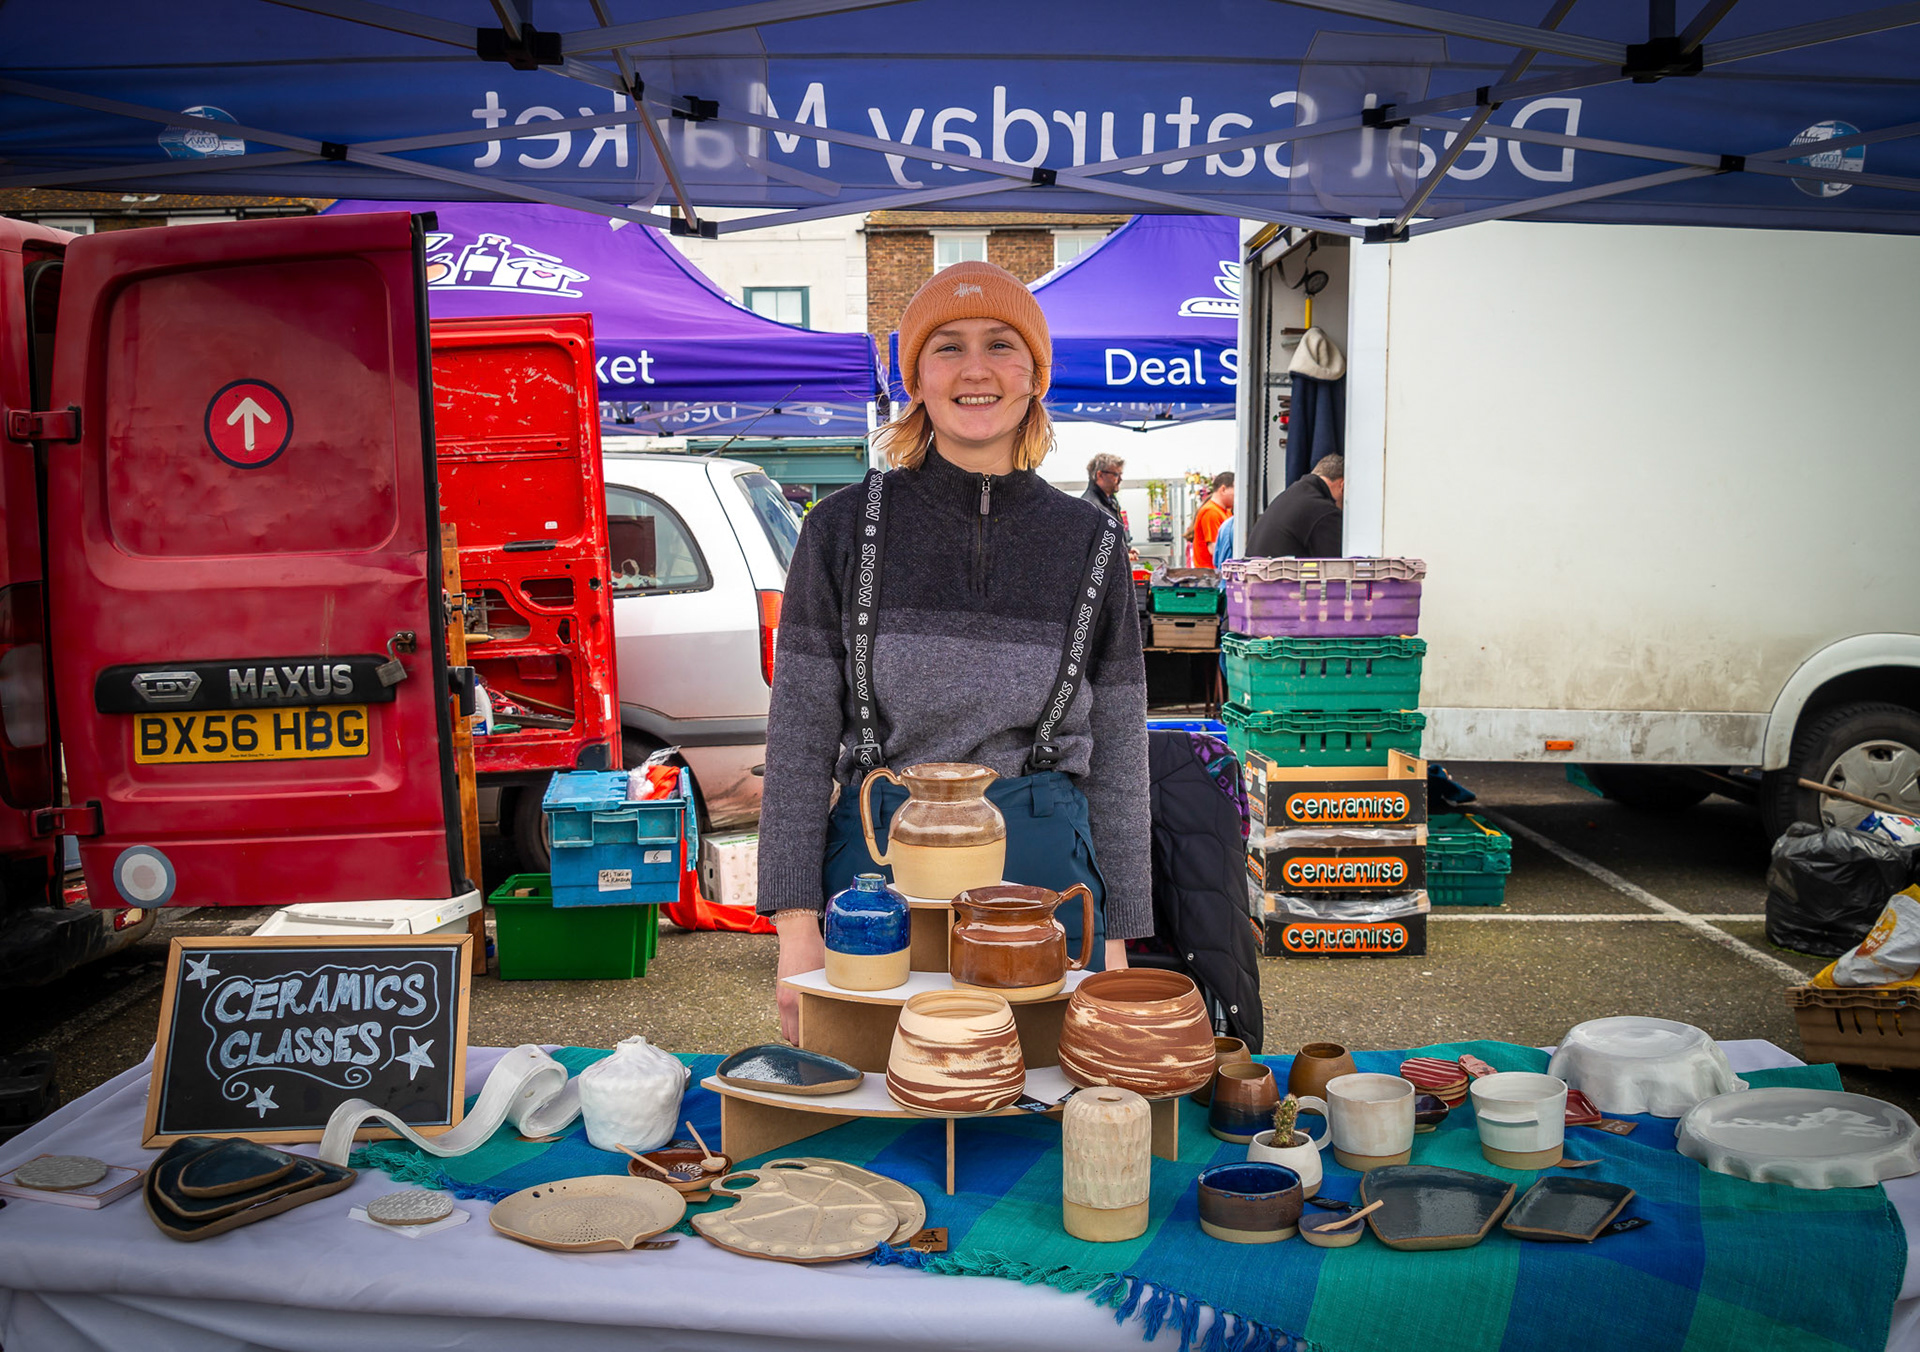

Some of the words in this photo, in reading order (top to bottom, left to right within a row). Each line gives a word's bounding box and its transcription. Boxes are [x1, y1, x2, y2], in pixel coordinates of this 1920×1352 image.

[1105, 348, 1206, 386] Deal
[865, 472, 884, 521] SNOW
[858, 543, 876, 607] SNOW
[1091, 530, 1116, 586] SNOW
[1070, 603, 1093, 662] SNOW
[140, 681, 197, 693] LDV
[228, 664, 354, 700] MAXUS
[855, 633, 869, 701] SNOW
[141, 713, 258, 756] BX56
[273, 709, 365, 751] HBG
[1040, 681, 1073, 741] SNOW
[1290, 796, 1406, 818] centramirsa
[1287, 860, 1404, 882] centramirsa
[1286, 926, 1405, 949] centramirsa
[215, 973, 427, 1023] CERAMICS
[219, 1021, 382, 1068] CLASSES
